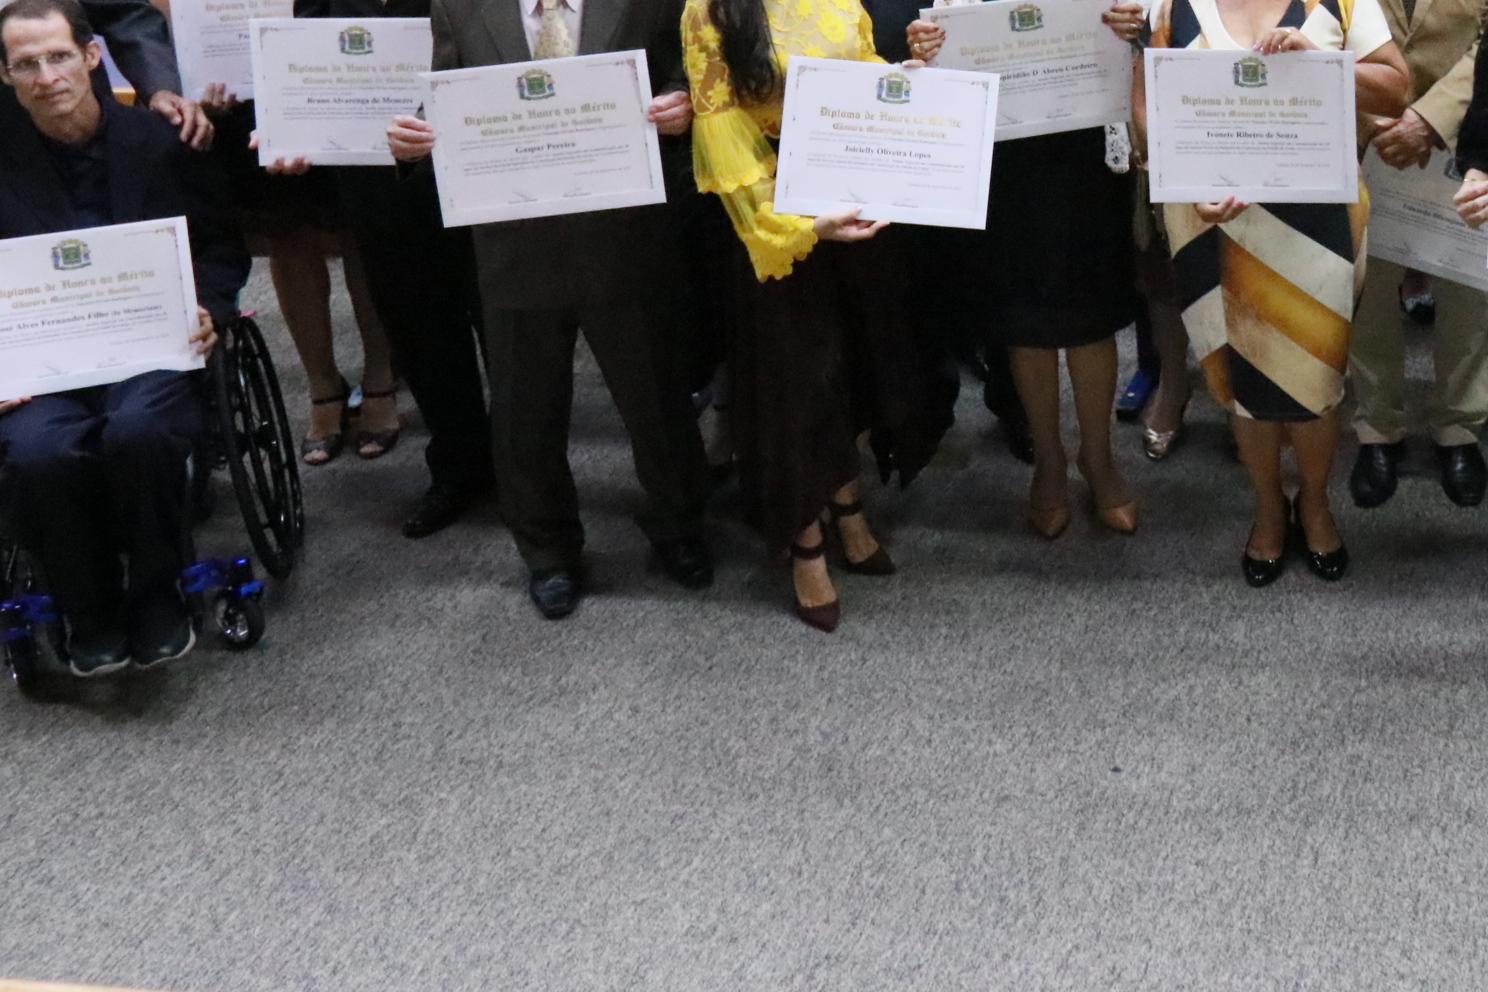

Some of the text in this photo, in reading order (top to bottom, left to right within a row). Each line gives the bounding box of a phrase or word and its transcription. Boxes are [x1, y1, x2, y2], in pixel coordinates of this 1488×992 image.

[1181, 95, 1221, 107] Diploma
[1225, 96, 1235, 106] de
[1239, 96, 1270, 106] Honra
[1288, 96, 1323, 107] Mérito
[464, 116, 508, 127] Diploma
[512, 112, 523, 121] de
[527, 107, 561, 119] Honra
[580, 101, 616, 113] Mérito
[820, 106, 861, 120] Diploma
[865, 112, 874, 121] de
[517, 122, 558, 133] Municipal
[1236, 131, 1263, 139] Ribeiro
[515, 141, 576, 154] Gaspar Pereira
[877, 147, 907, 157] Oliveira
[909, 151, 931, 159] Lopes
[61, 278, 96, 290] Honra
[117, 269, 155, 282] Mérito
[16, 321, 39, 331] Alves
[41, 315, 85, 326] Fernandes
[87, 311, 109, 319] Filho
